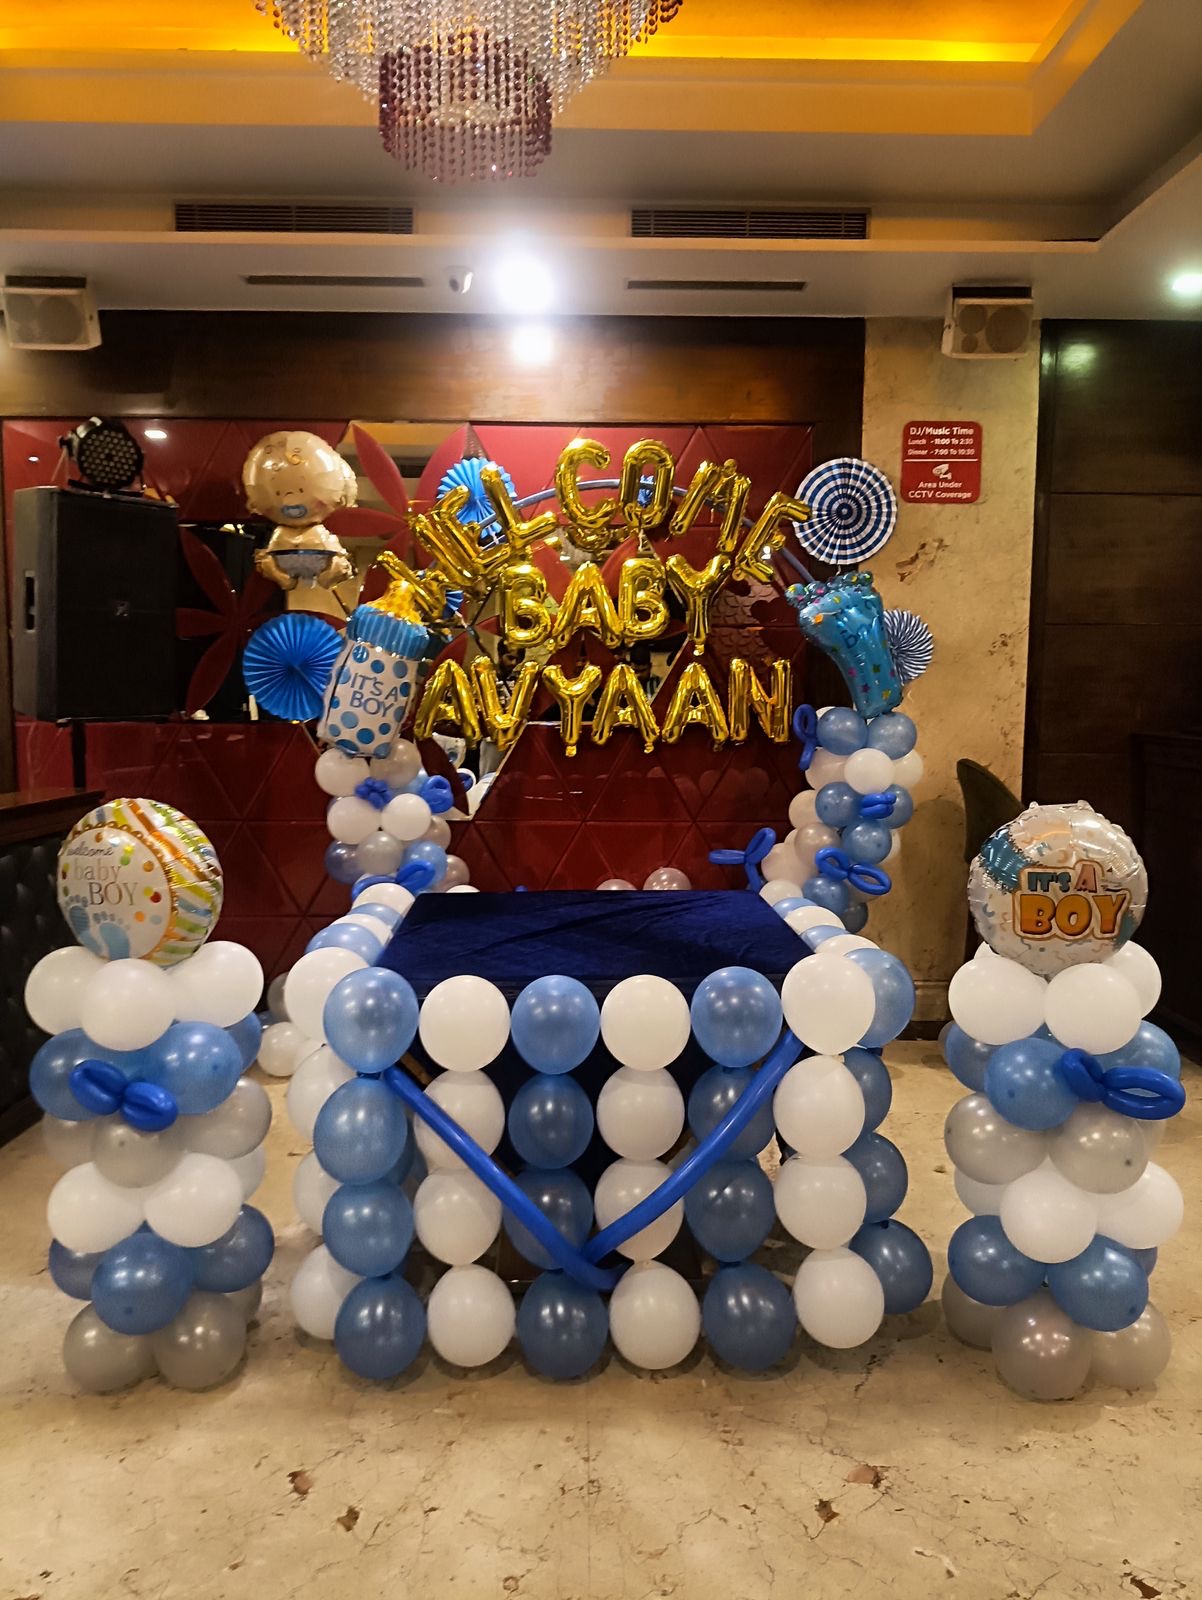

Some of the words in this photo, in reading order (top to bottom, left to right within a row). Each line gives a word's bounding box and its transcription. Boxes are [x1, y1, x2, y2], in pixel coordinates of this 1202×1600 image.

[909, 426, 951, 436] DJ/Music
[952, 426, 975, 435] Time
[907, 448, 928, 456] Dinner
[950, 448, 958, 456] To
[958, 448, 976, 456] 10:30
[908, 490, 934, 499] CCTV
[935, 490, 973, 500] Coverage
[918, 481, 937, 489] Area
[938, 481, 963, 489] Under
[499, 554, 731, 656] BABY
[350, 672, 385, 697] IT'S
[384, 685, 400, 703] A
[349, 690, 396, 718] BOY
[414, 655, 793, 757] AVYAAN
[74, 857, 121, 884] baby
[1027, 870, 1072, 893] IT'S
[1074, 862, 1098, 894] A
[87, 880, 139, 907] BOY
[1019, 893, 1127, 937] BOY
